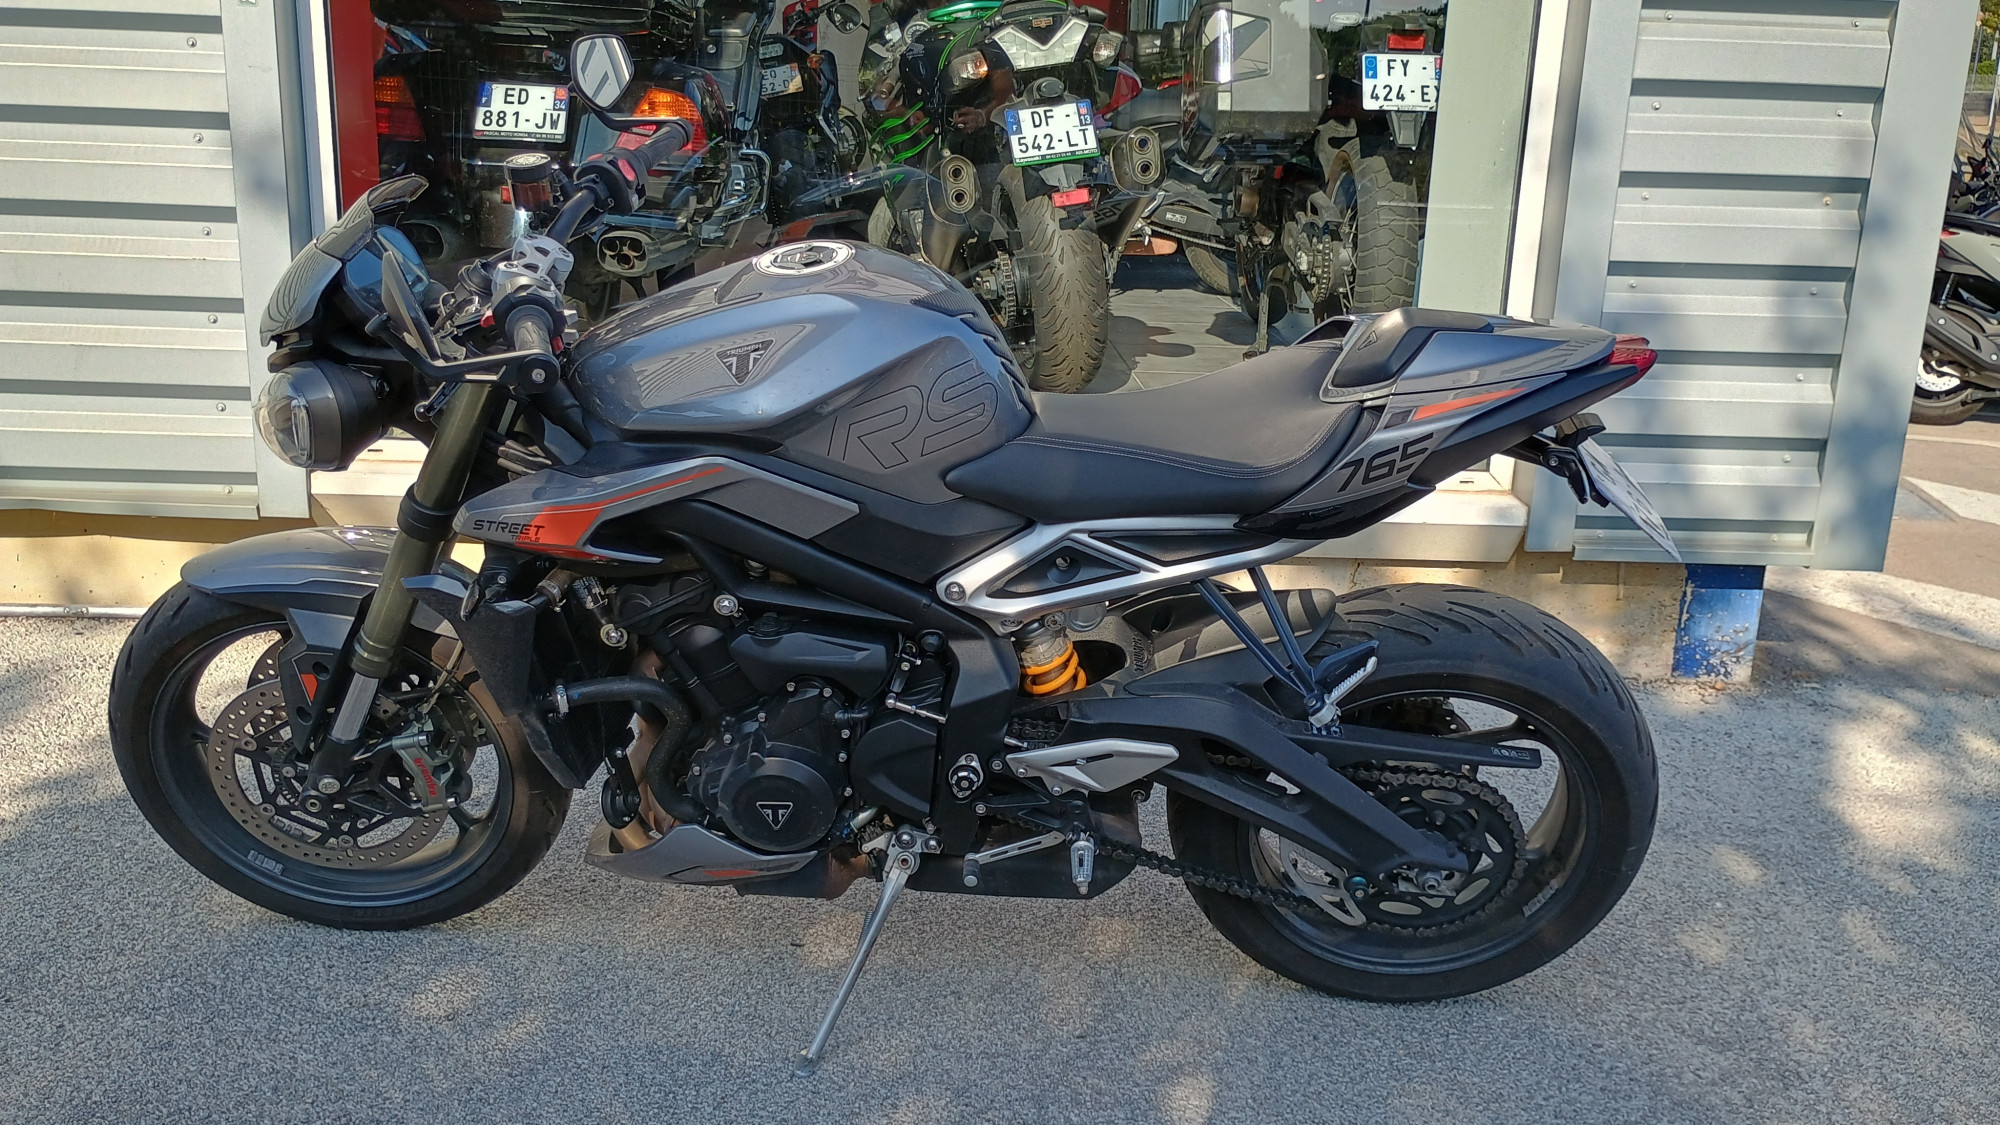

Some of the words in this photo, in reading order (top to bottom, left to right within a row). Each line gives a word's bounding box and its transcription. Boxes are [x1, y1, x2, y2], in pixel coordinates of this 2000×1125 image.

[1387, 59, 1409, 76] FY
[504, 88, 529, 104] ED
[554, 100, 566, 110] 34
[482, 110, 560, 130] 881-JW
[1031, 109, 1054, 128] DF
[1080, 116, 1091, 125] 13
[1018, 128, 1088, 154] 542-LT
[1016, 155, 1042, 164] Kawasaki
[727, 344, 762, 356] TRIUMPH
[827, 358, 998, 469] RS
[1337, 431, 1434, 493] 765
[472, 520, 545, 536] STREET
[413, 758, 438, 796] brembo
